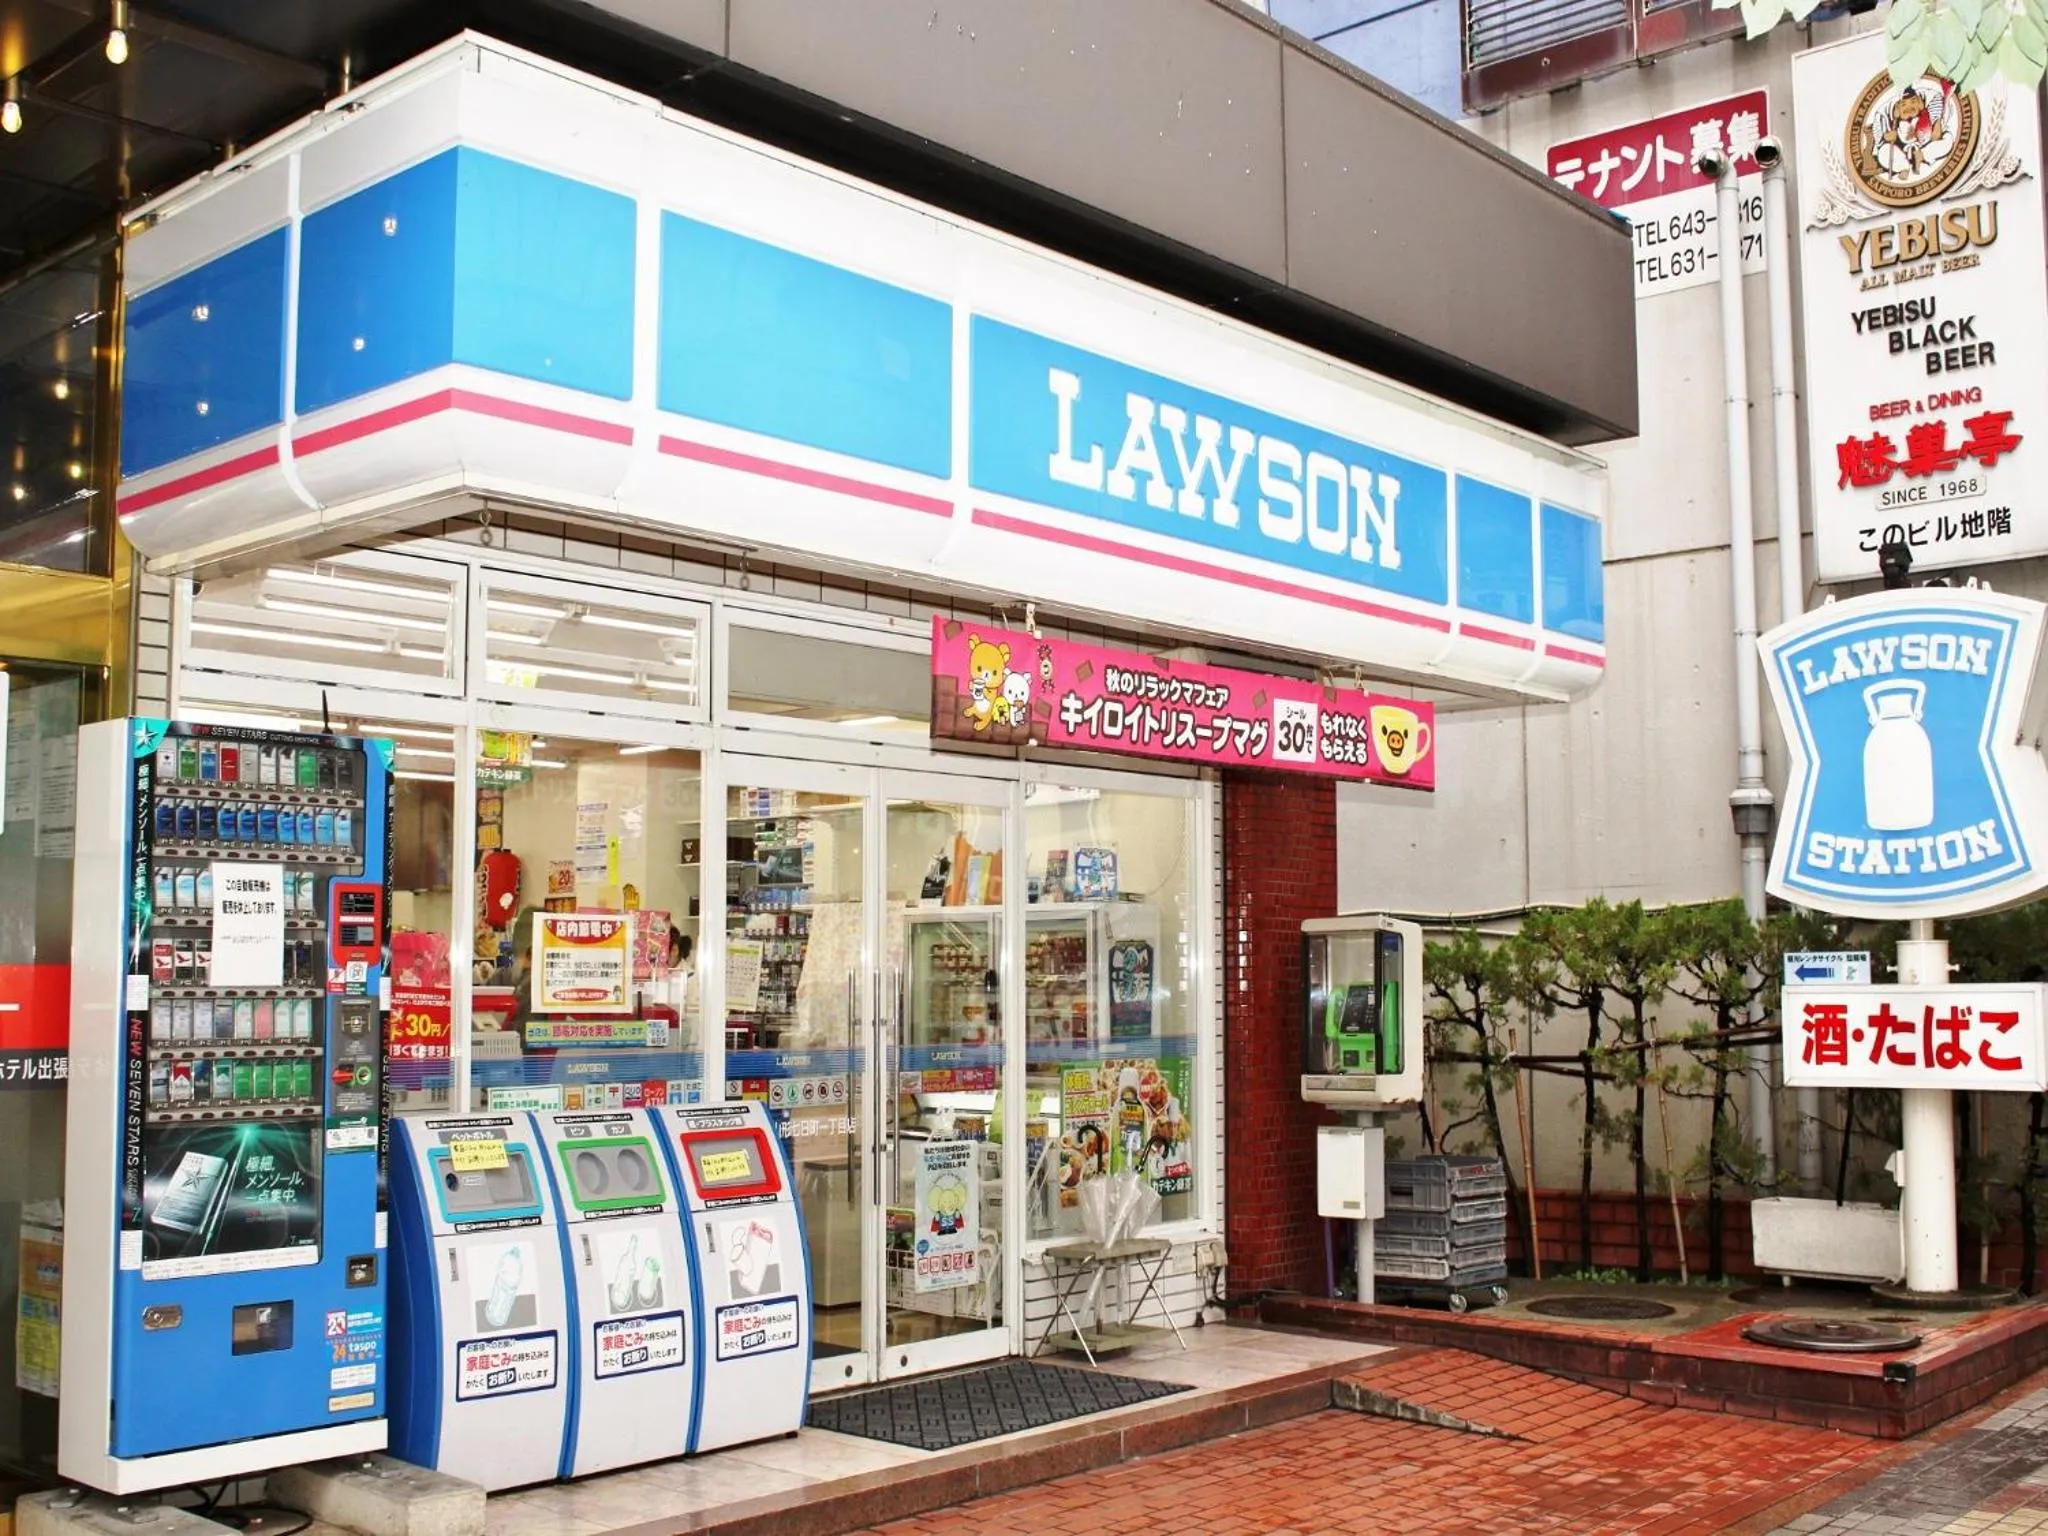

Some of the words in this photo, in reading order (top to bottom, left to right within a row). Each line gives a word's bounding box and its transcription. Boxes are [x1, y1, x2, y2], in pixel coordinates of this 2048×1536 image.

[1554, 110, 1760, 199] テナント募集
[1867, 177, 1914, 199] SAPPORO
[1635, 221, 1667, 249] TEL
[1838, 200, 1999, 274] YEBISU
[1636, 257, 1668, 284] TEL
[1859, 273, 1890, 292] ALL
[1893, 261, 1936, 285] MALT
[1941, 253, 1981, 274] BEER
[1851, 296, 1937, 335] YEBISU
[1888, 315, 1978, 355] BLACK
[1926, 341, 1997, 376] BEER
[1869, 399, 1911, 422] BEER
[1914, 400, 1925, 413] &
[1927, 386, 1983, 412] DINING
[1048, 367, 1402, 571] LAWSON
[1881, 486, 1927, 506] SINCE
[1939, 478, 1978, 497] 1968
[1858, 506, 2012, 552] このビル地階
[1797, 633, 1992, 696] LAWSON
[1104, 667, 1230, 709] 秋のリラックマフェア
[241, 730, 267, 740] STARS
[1060, 692, 1269, 757] キイロイトリスープマグ
[1278, 720, 1305, 753] 30
[1321, 712, 1367, 740] もれなく
[1321, 736, 1367, 764] もらえる
[1806, 818, 2003, 875] STATION
[130, 1018, 143, 1057] NEW
[1801, 1002, 2023, 1072] 酒・たばこ
[0, 1057, 68, 1080] テル出張
[128, 1058, 142, 1113] SEVEN
[126, 1115, 141, 1167] STARS
[348, 1340, 377, 1354] taspo
